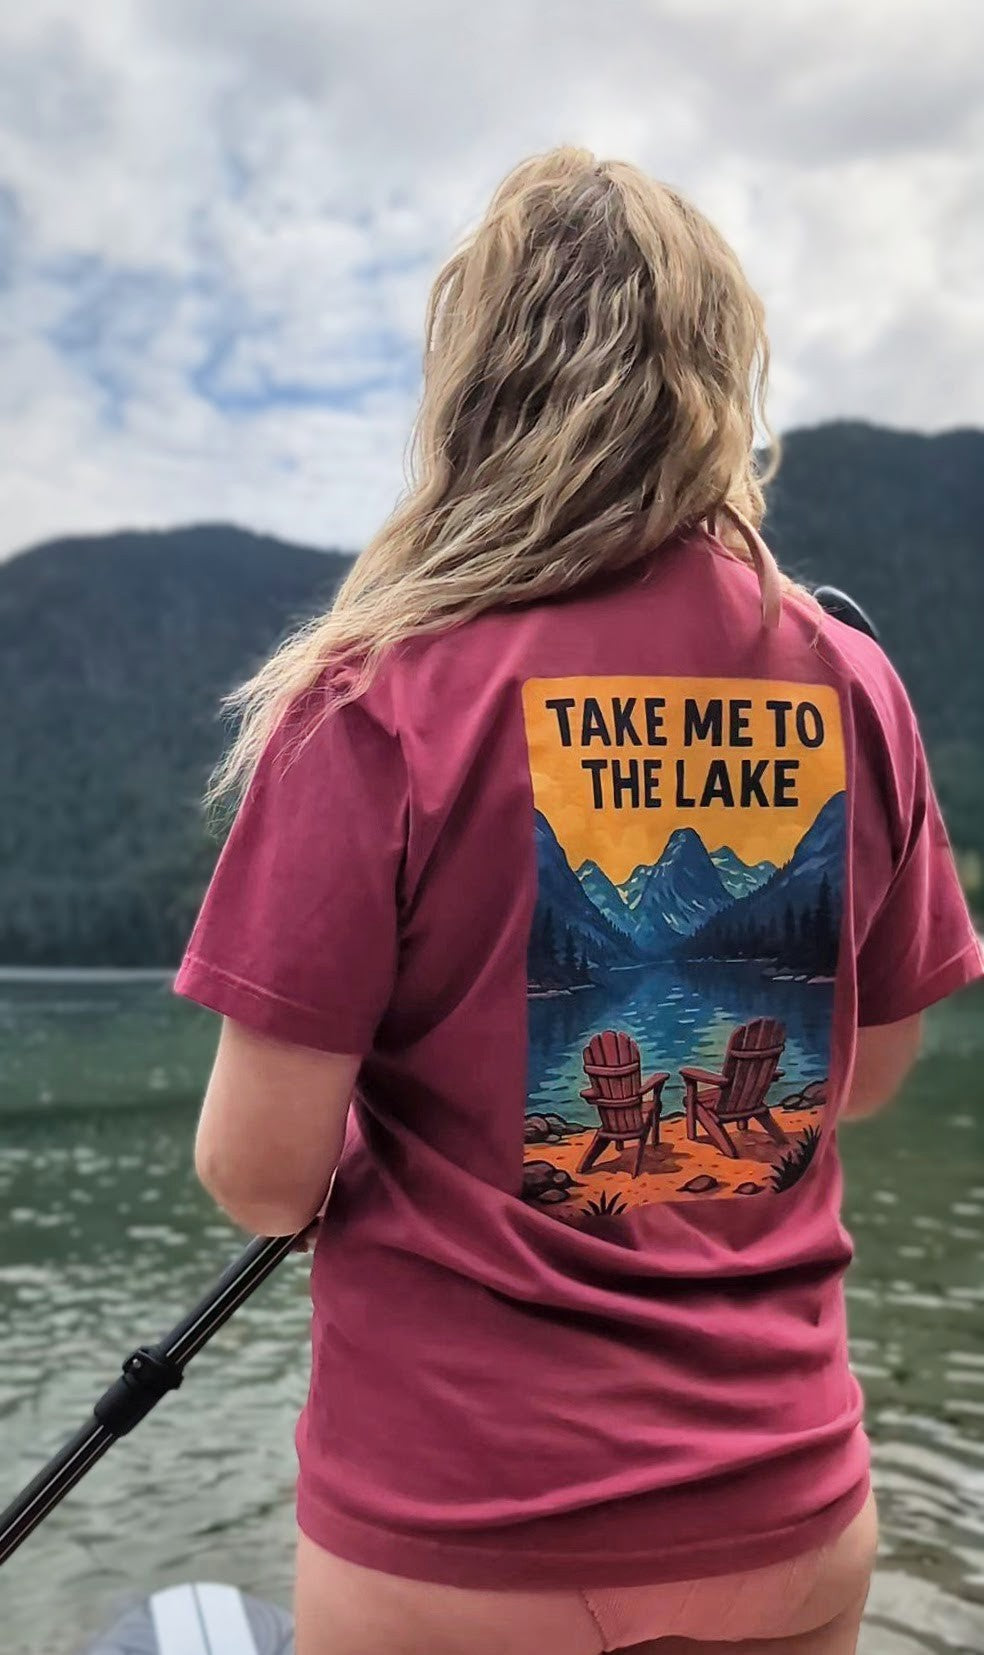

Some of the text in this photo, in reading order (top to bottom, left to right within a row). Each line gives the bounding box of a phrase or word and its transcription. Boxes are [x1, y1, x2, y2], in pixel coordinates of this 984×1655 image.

[545, 697, 825, 749] TAKE ME TO
[581, 758, 800, 810] THE LAKE
